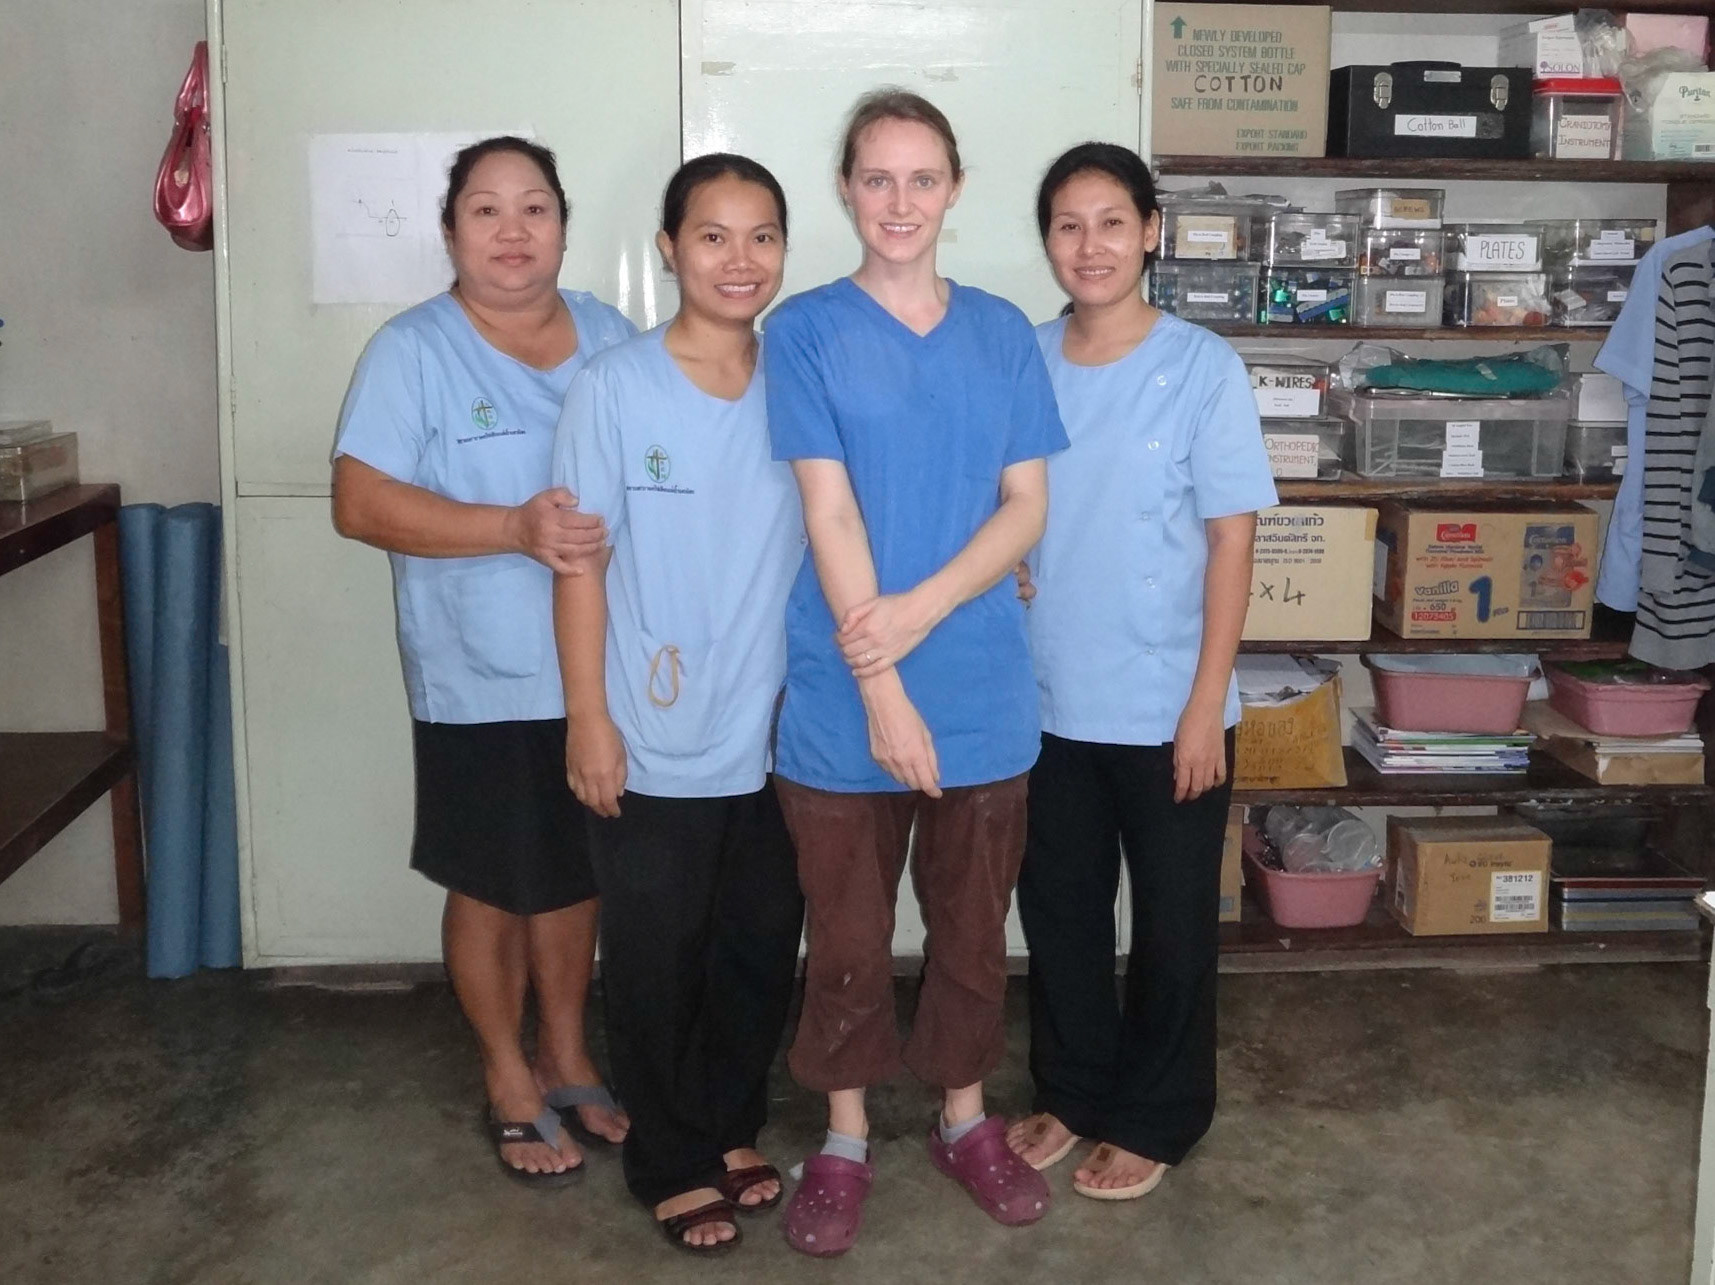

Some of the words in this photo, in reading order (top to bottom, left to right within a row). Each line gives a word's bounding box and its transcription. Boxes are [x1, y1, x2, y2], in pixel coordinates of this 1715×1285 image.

[1192, 29, 1226, 43] NEWLY
[1230, 31, 1283, 44] DEVELOPED
[1177, 44, 1214, 57] CLOSED
[1218, 46, 1257, 59] SYSTEM
[1260, 46, 1296, 60] BOTTLE
[1165, 60, 1191, 73] WITH
[1195, 61, 1245, 74] SPECIALLY
[1249, 62, 1284, 75] SEALED
[1287, 63, 1306, 76] CAP
[1194, 74, 1284, 93] COTTON
[1170, 97, 1193, 110] SAFE
[1197, 98, 1223, 110] FROM
[1226, 98, 1299, 112] CONTAMINATION
[1407, 117, 1444, 132] Cotton
[1448, 119, 1466, 130] Ball
[1236, 128, 1267, 139] EXPORT
[1269, 129, 1308, 139] STANDARD
[1558, 134, 1611, 148] INSTRUMENT
[1235, 141, 1265, 151] EXPORT
[1267, 141, 1300, 151] PACKING
[1480, 240, 1526, 260] PLATES
[1259, 375, 1313, 390] K-WIRES
[1283, 577, 1306, 606] 4
[1469, 575, 1493, 623] 1
[1429, 603, 1447, 611] 650
[1502, 874, 1534, 883] 381212
